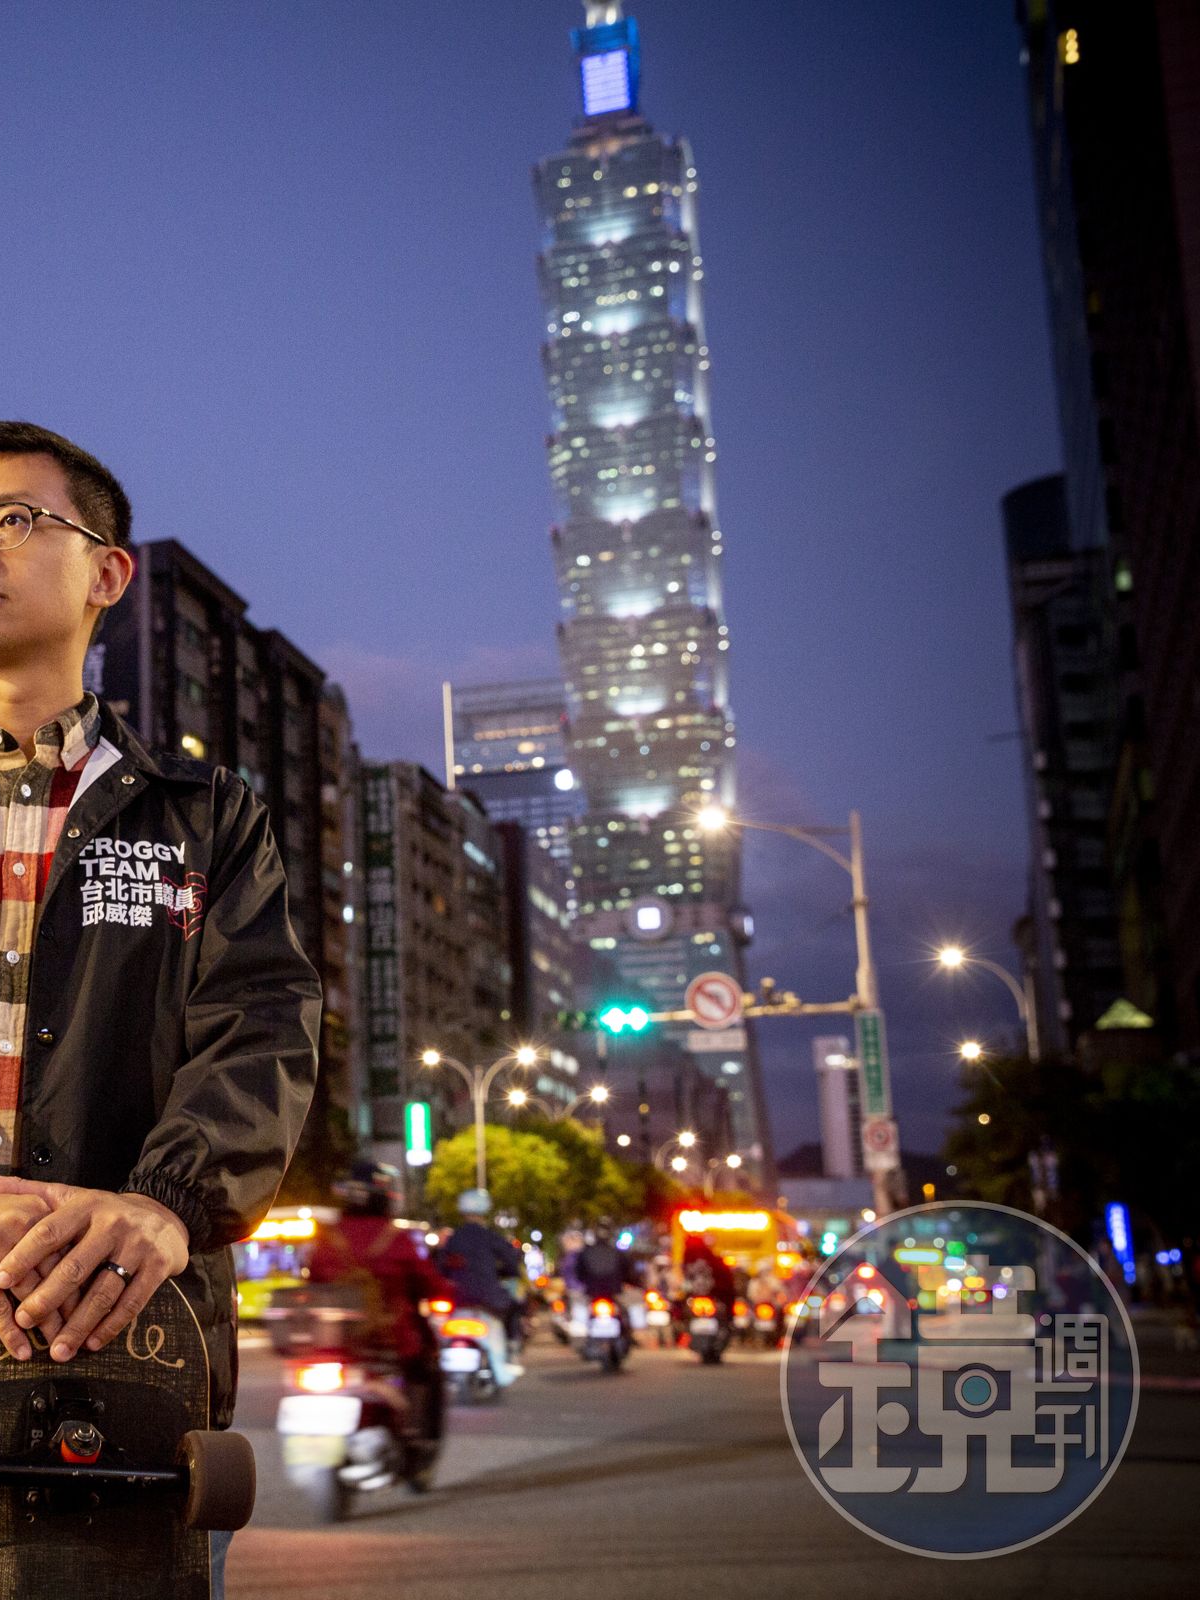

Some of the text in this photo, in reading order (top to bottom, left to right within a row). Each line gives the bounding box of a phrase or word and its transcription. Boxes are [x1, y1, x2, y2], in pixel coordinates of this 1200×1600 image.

[79, 837, 185, 864] FROGGY
[79, 857, 160, 881] TEAM
[80, 878, 195, 912] 台北市議員
[82, 902, 153, 927] 邱威傑
